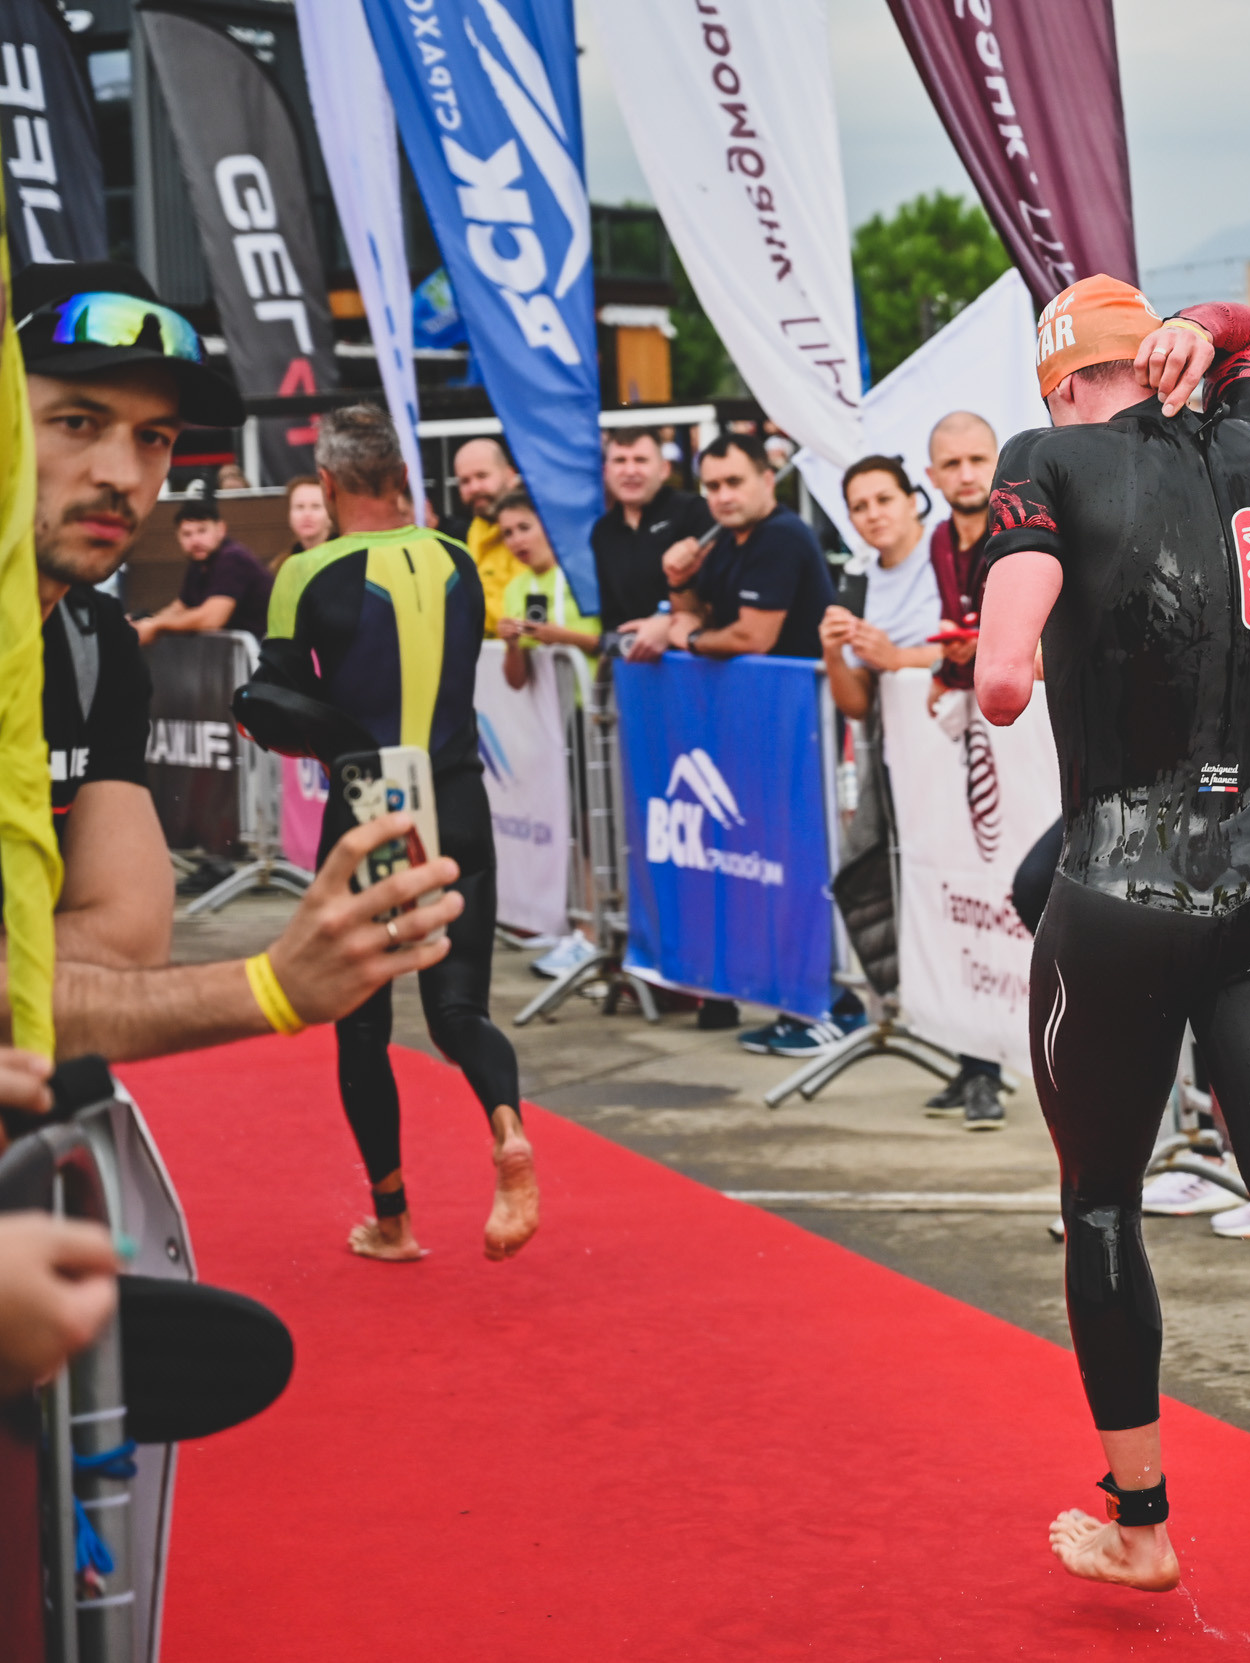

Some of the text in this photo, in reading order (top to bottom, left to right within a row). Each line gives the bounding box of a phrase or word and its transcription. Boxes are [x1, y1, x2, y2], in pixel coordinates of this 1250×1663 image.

[1201, 762, 1239, 775] designed
[1200, 773, 1238, 786] in france
[646, 797, 709, 871] ВСК
